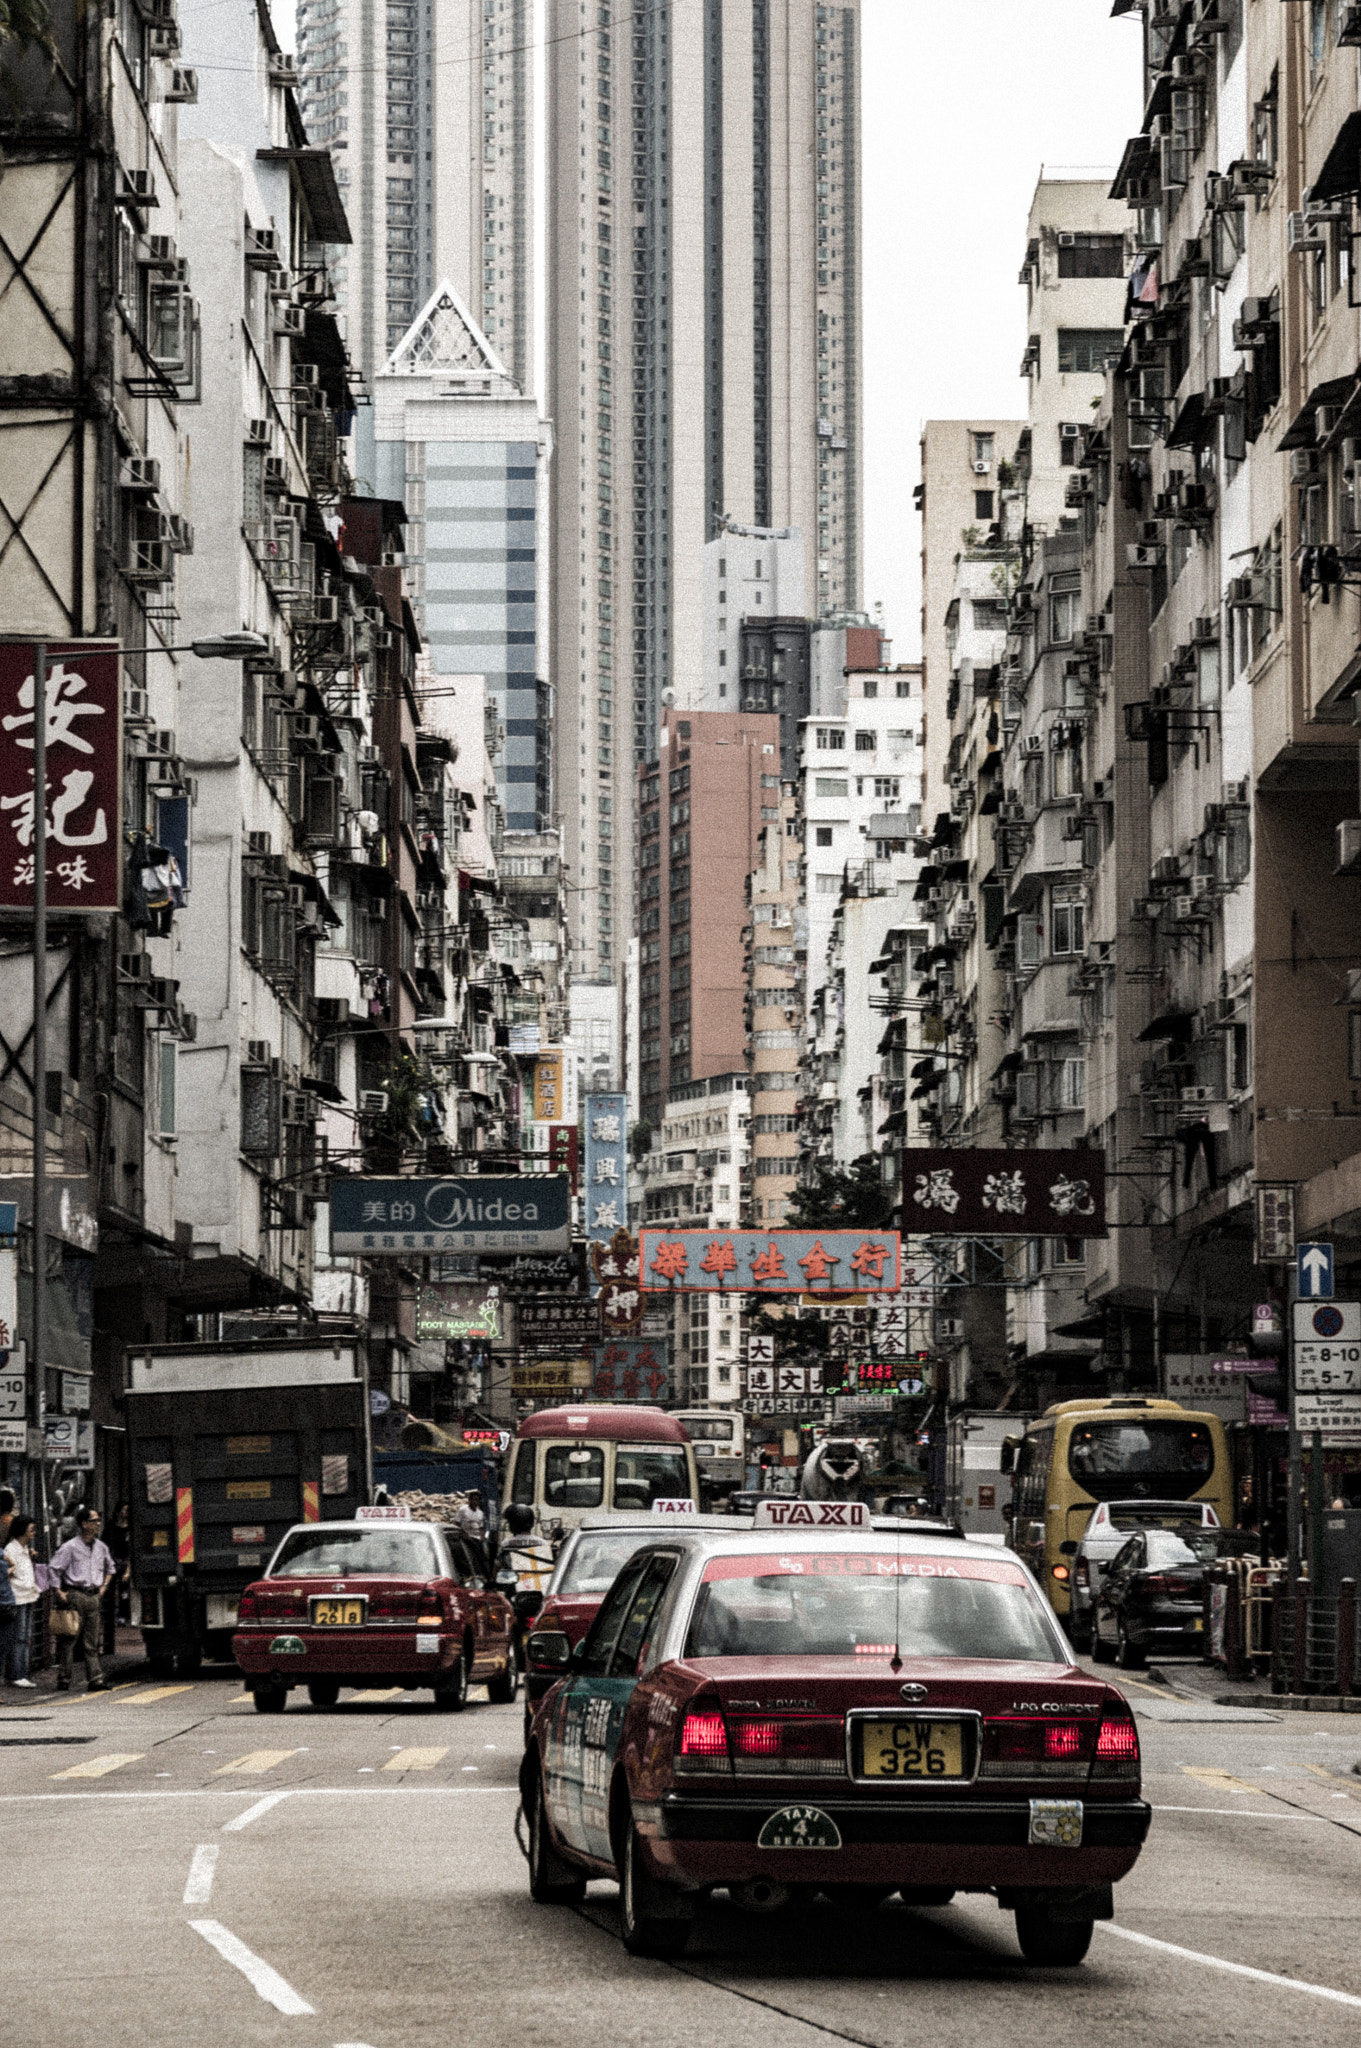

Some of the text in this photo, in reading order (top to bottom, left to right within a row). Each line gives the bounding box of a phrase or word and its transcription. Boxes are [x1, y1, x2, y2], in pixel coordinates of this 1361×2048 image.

[1, 662, 107, 847] 安記
[362, 1197, 539, 1223] 美的 Midea
[605, 1285, 640, 1321] 押
[420, 1321, 487, 1329] FOOT MASSAGE
[882, 1306, 905, 1355] 五金
[1298, 1355, 1318, 1364] 上午
[1320, 1348, 1360, 1362] 8-10
[1301, 1368, 1315, 1376] pm
[0, 1380, 23, 1393] -10
[583, 1370, 667, 1398] 中醫藥
[1299, 1377, 1318, 1386] 下午
[1316, 1398, 1343, 1406] Except
[360, 1507, 407, 1518] TAXI
[657, 1501, 693, 1513] TAXI
[766, 1503, 863, 1526] TAXI
[877, 1561, 959, 1578] MEDIA
[1041, 1702, 1100, 1713] COMFORT
[892, 1723, 932, 1748] CW
[879, 1749, 946, 1774] 326
[784, 1809, 820, 1823] TAXI
[793, 1819, 807, 1837] 4
[773, 1835, 827, 1847] SEATS
